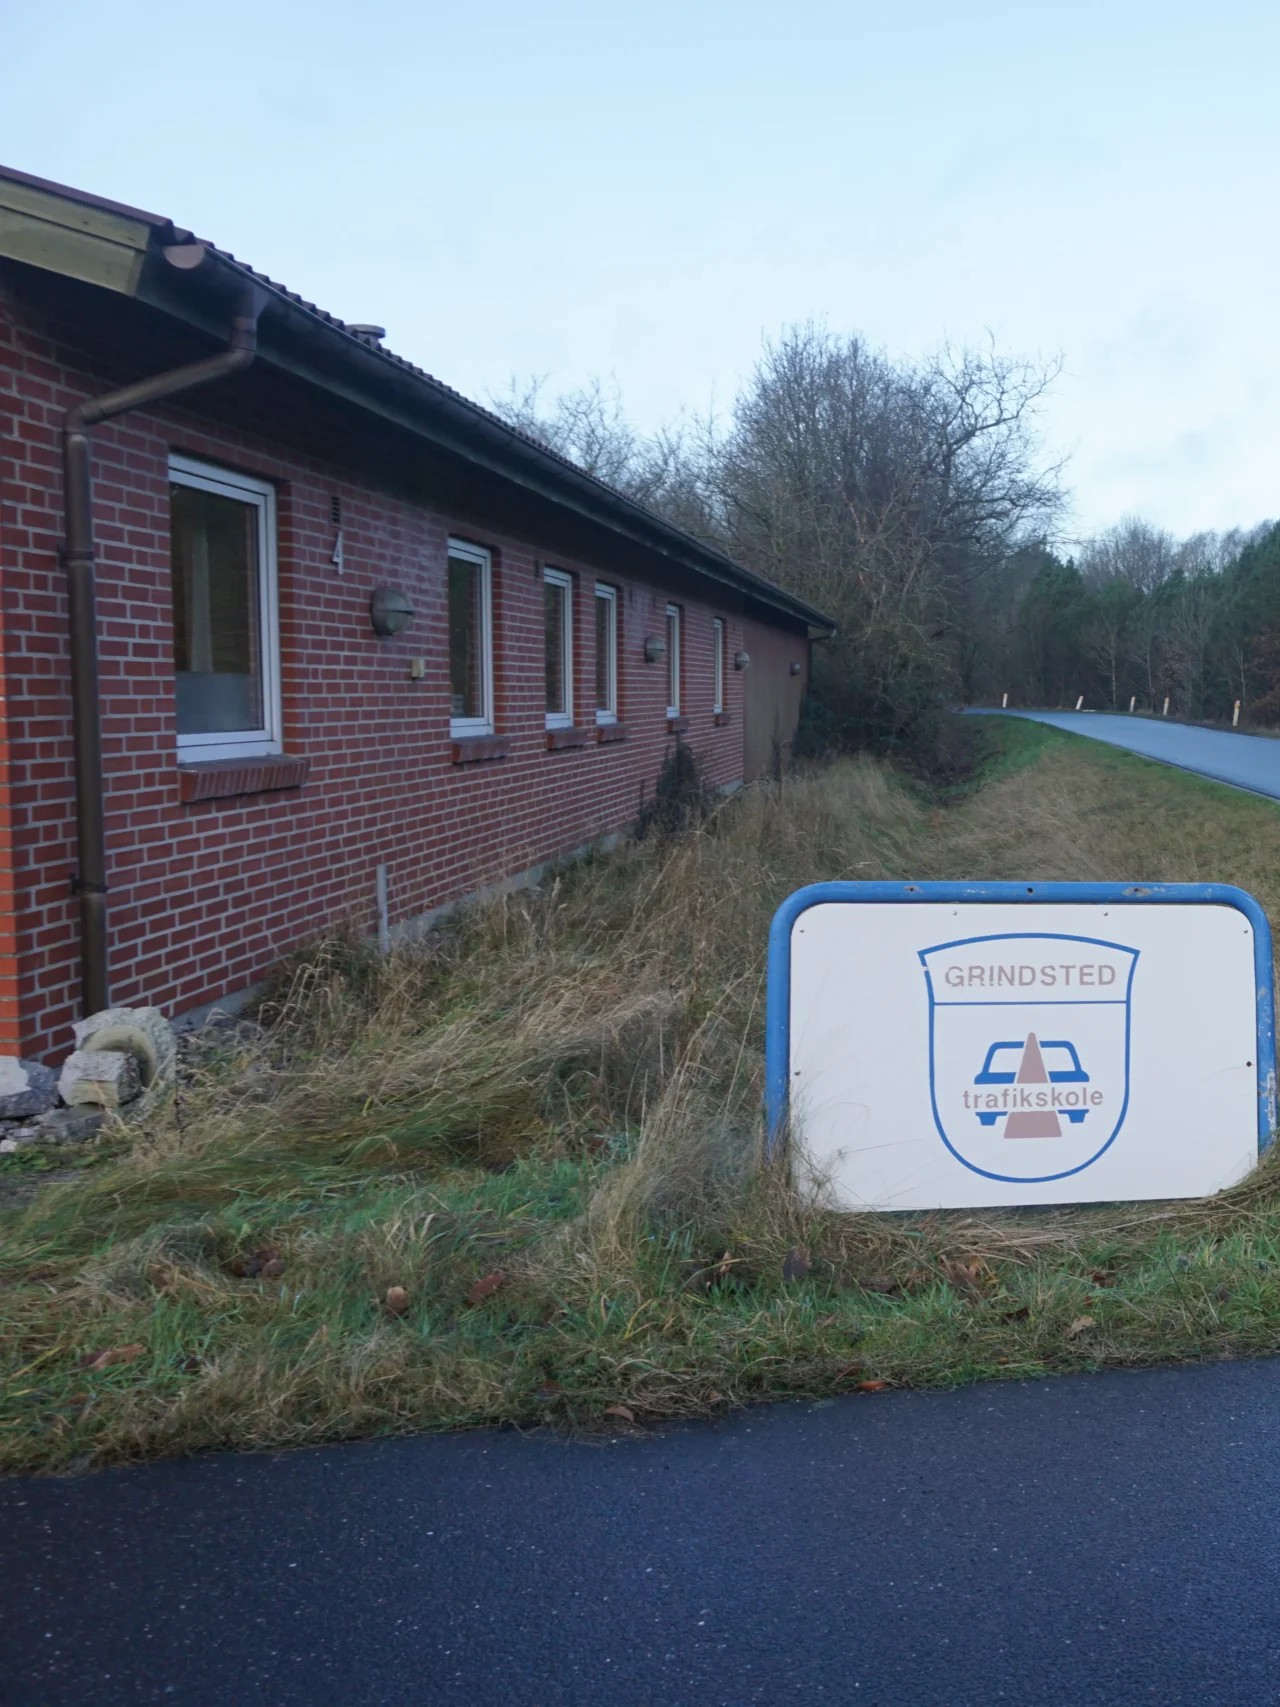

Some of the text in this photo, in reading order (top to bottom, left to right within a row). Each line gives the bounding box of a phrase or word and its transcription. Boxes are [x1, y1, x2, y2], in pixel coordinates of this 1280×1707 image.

[332, 531, 343, 574] 4
[944, 964, 1116, 987] GRINDSTED
[962, 1087, 1104, 1109] trafikskole
